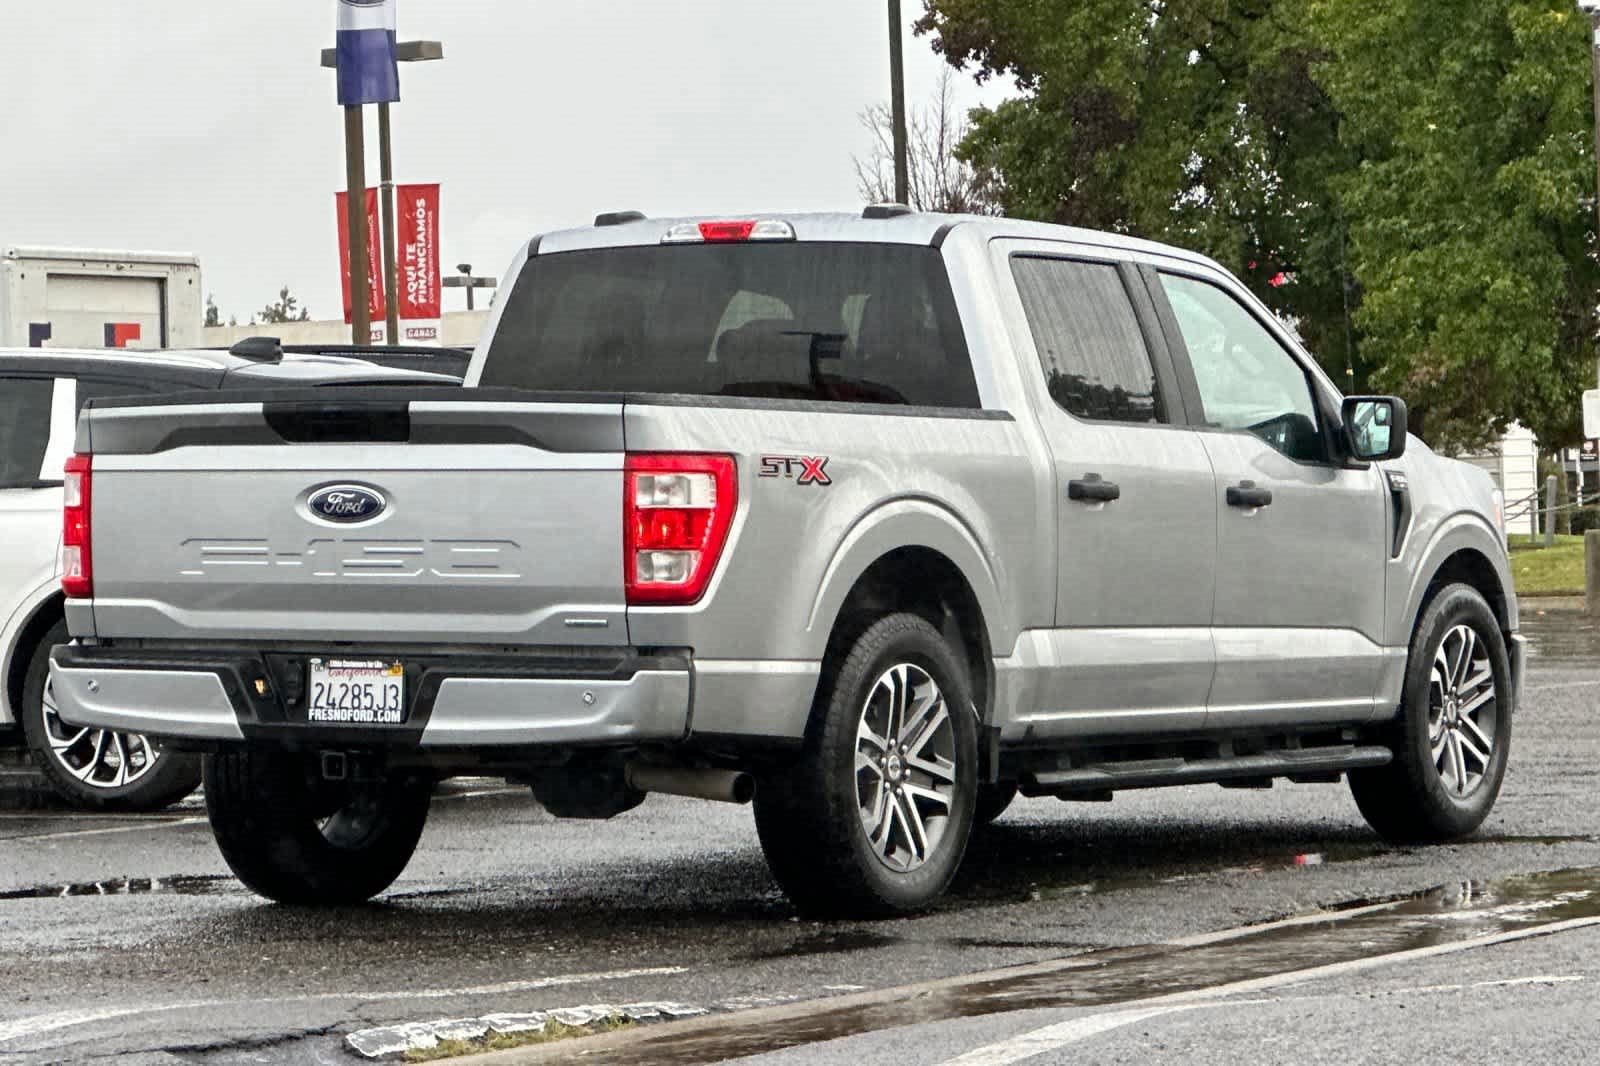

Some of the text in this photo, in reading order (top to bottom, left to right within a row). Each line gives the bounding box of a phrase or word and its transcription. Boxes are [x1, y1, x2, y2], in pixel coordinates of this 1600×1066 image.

[416, 198, 427, 304] FINANCIAMOS
[404, 243, 418, 304] AQUÍ TE
[758, 455, 832, 486] STX
[323, 491, 365, 514] Ford
[180, 538, 521, 578] F-150
[314, 682, 399, 710] 24285J3
[308, 708, 401, 722] FRESNOFORD.COM
